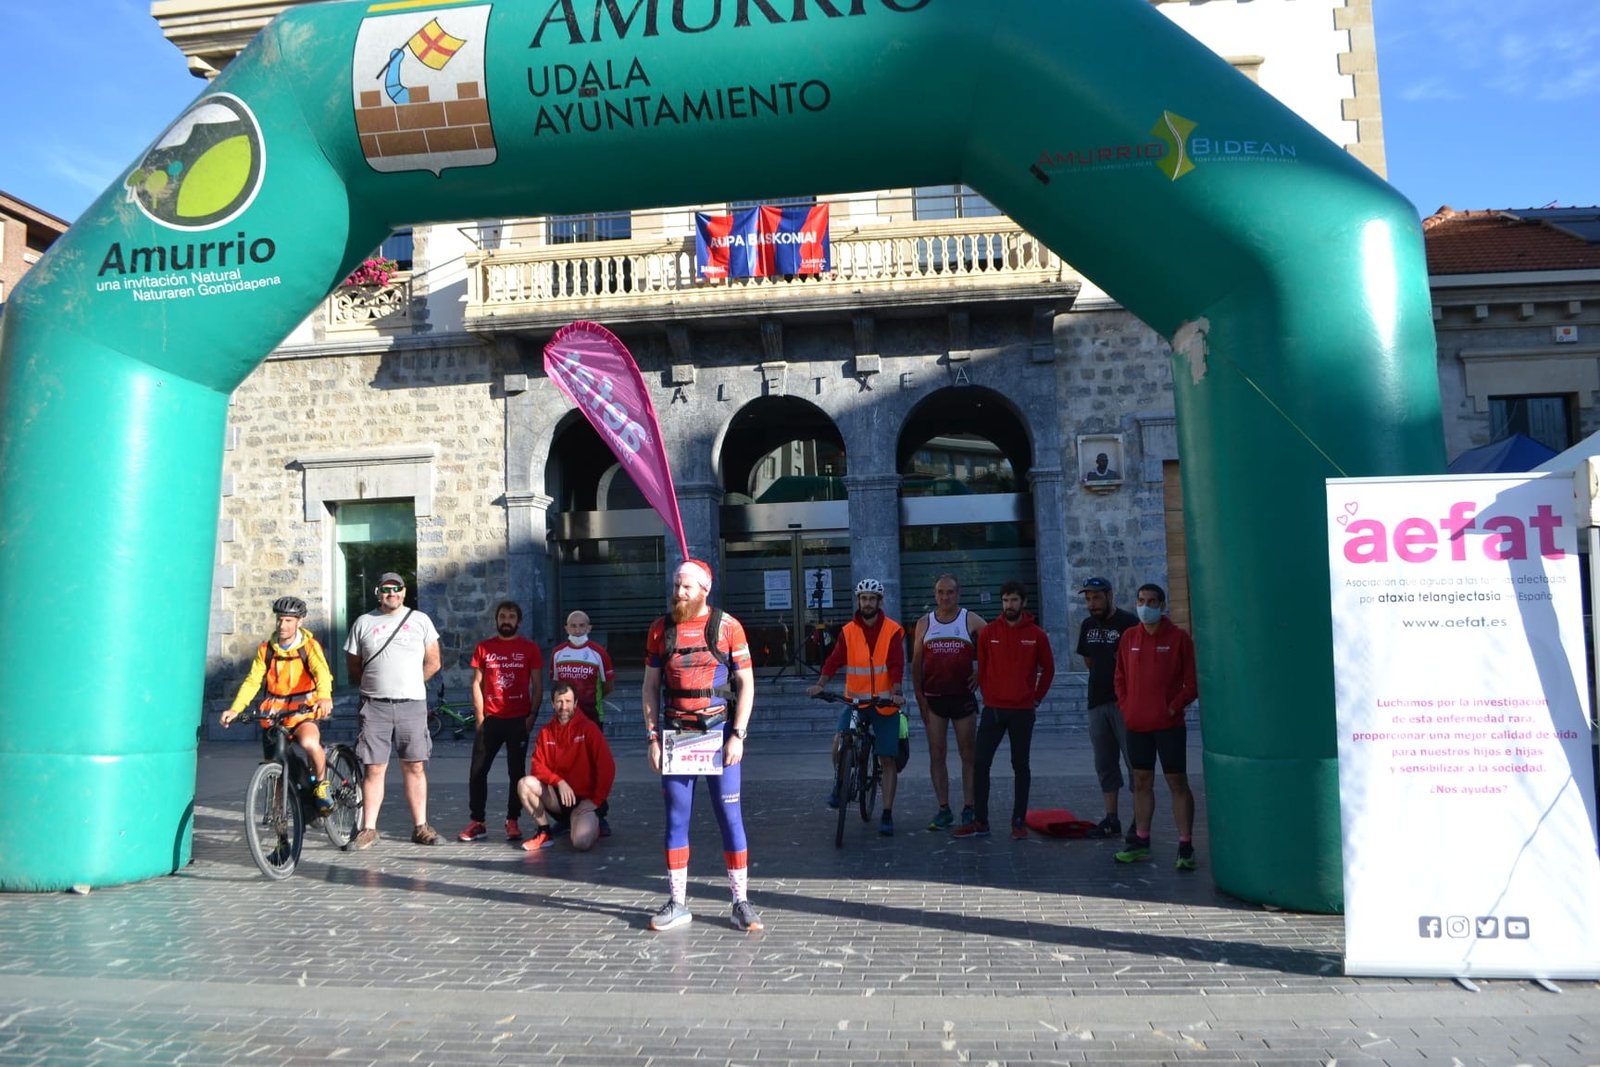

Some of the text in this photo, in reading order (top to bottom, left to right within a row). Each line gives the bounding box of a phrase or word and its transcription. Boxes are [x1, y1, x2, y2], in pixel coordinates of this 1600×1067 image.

[528, 56, 651, 97] UDALA
[534, 79, 831, 136] AYUNTAMIENTO
[1036, 143, 1164, 168] AMURRIO
[1192, 138, 1297, 157] BIDEAN
[710, 234, 745, 248] AUPA
[97, 232, 276, 277] Amurrio
[96, 268, 242, 292] una invitación Natural
[133, 275, 281, 302] Naturaren Gonbidapena
[1343, 501, 1566, 564] aefat
[1419, 577, 1454, 588] agrupa
[1456, 577, 1464, 586] a
[1465, 576, 1478, 585] las
[1359, 595, 1375, 605] por
[1377, 592, 1415, 603] ataxia
[1418, 590, 1501, 604] telangiectasia
[1518, 590, 1553, 602] España
[1402, 615, 1508, 628] www.aefat.es
[1377, 698, 1549, 709] Luchamos por la investigación
[1392, 714, 1406, 723] de
[1409, 715, 1433, 723] esta
[1436, 714, 1505, 723] enfermedad
[1352, 730, 1578, 741] proporcionar una mejor calidad de vida
[1392, 747, 1544, 758] para nuestros hijos e hijas
[1399, 764, 1465, 773] sensibilizar
[1478, 764, 1488, 773] la
[1492, 763, 1546, 773] sociedad.
[1430, 784, 1508, 795] ¿Nos ayudas?
